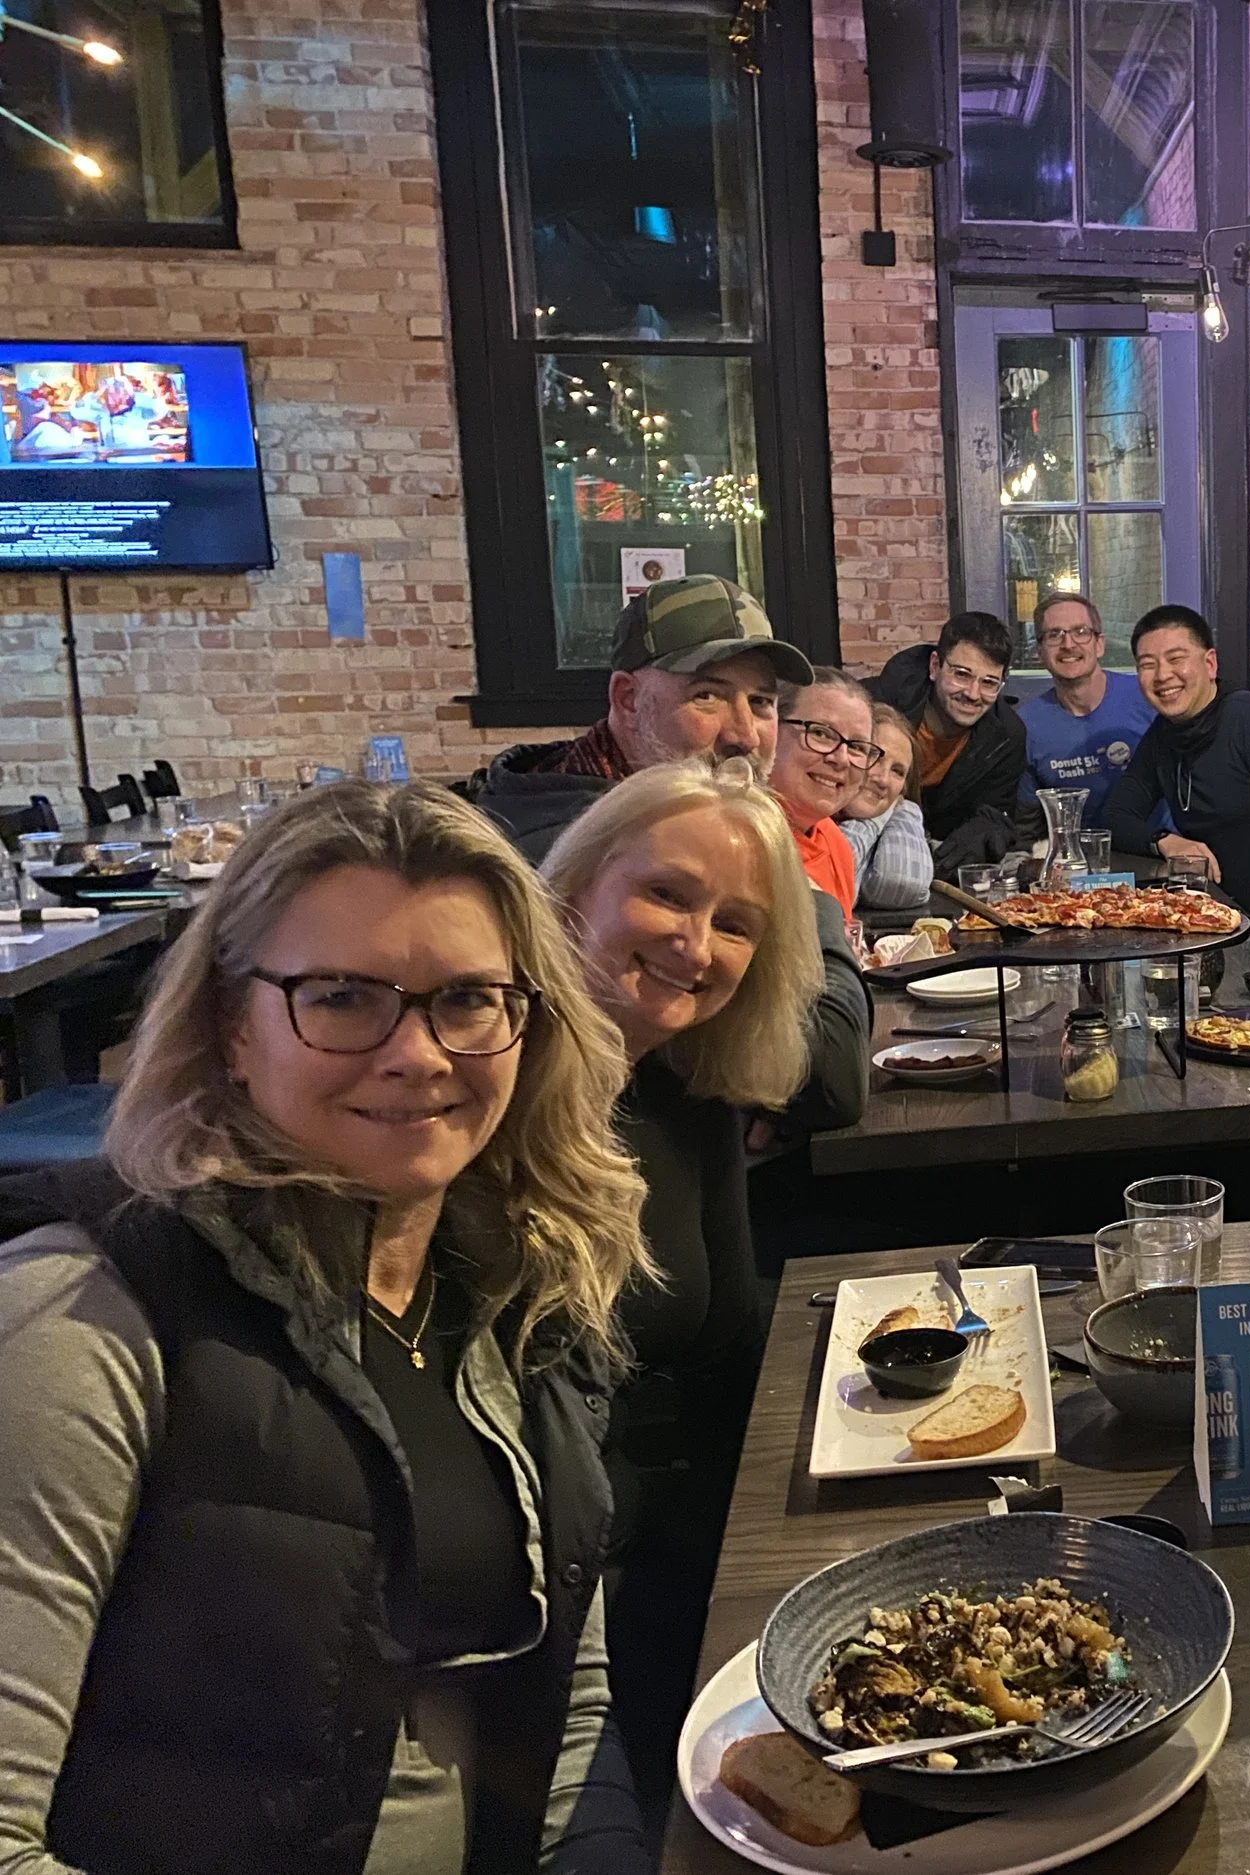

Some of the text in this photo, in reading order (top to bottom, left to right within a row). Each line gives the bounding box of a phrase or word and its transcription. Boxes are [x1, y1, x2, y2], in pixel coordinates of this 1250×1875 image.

[1050, 757, 1083, 769] Donut
[1058, 767, 1085, 778] Dash
[1218, 1303, 1248, 1320] BEST
